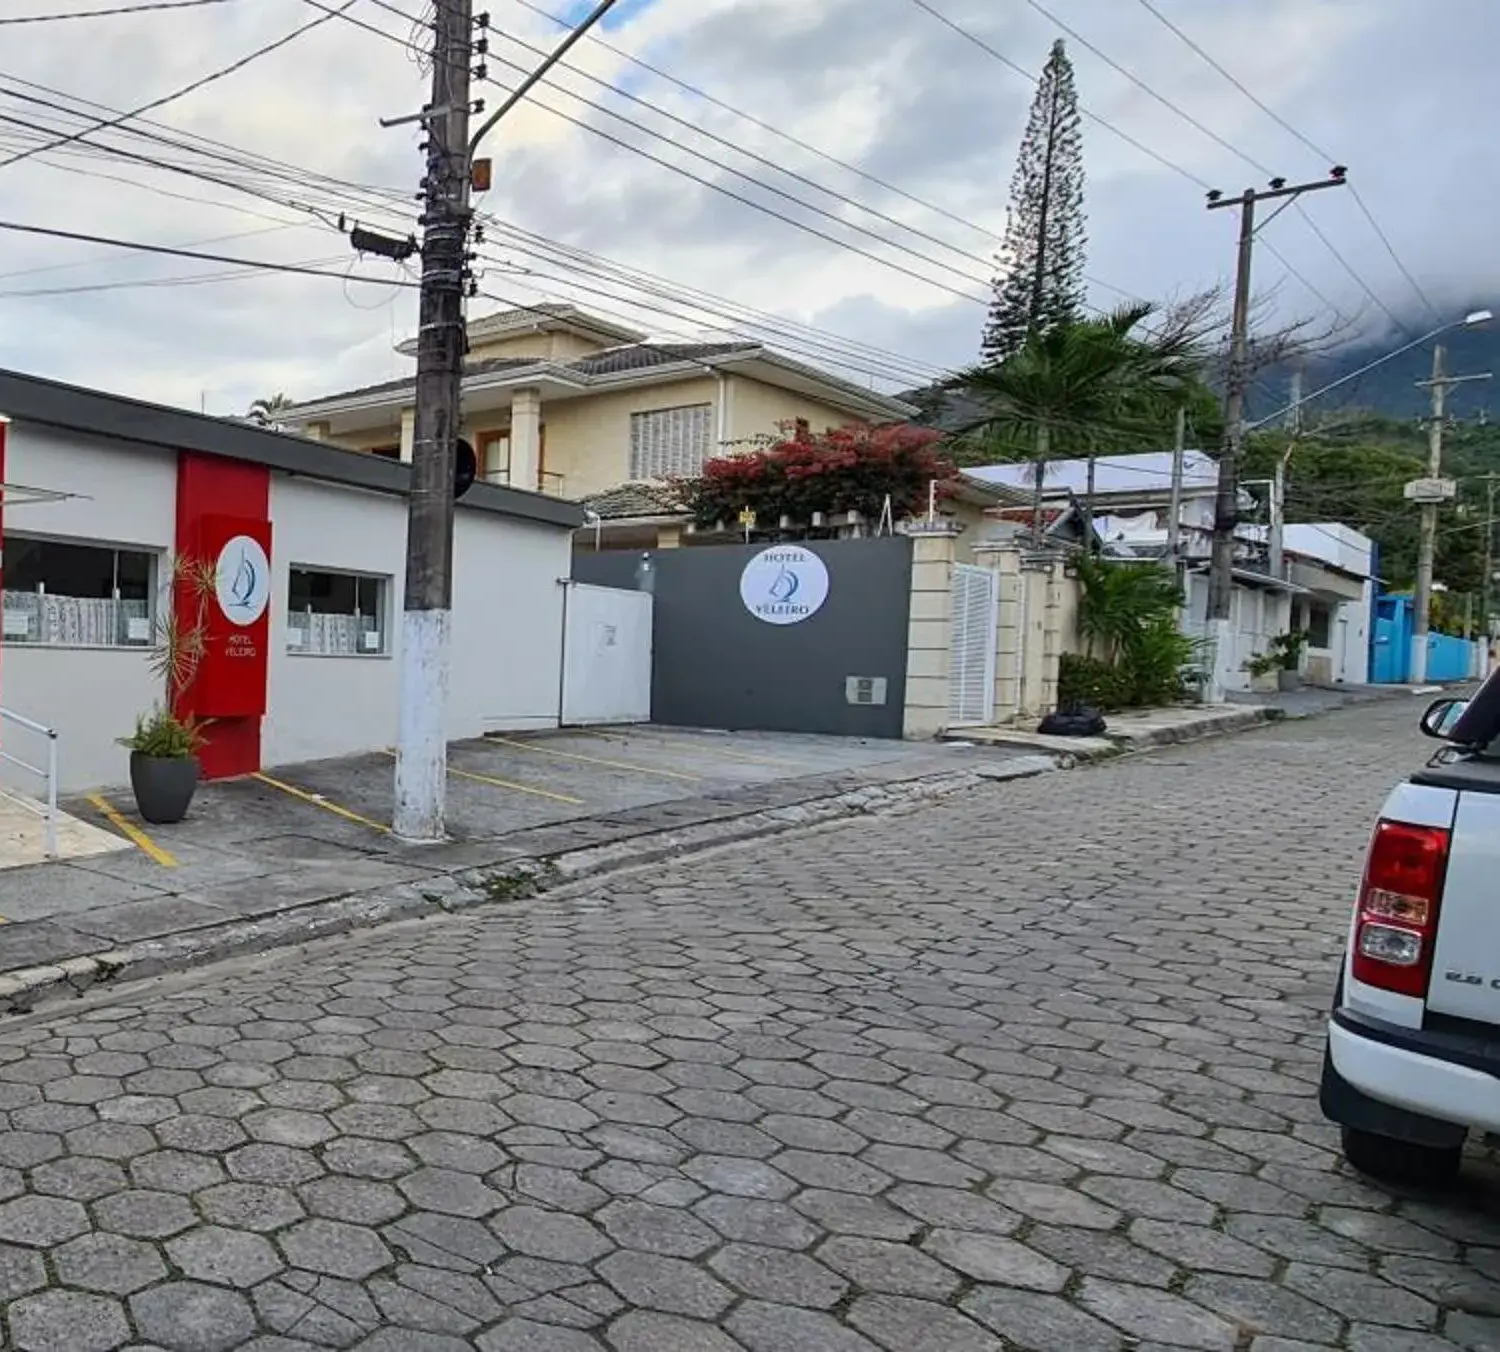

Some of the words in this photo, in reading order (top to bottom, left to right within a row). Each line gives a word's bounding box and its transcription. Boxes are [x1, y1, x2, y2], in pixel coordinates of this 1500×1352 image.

[764, 553, 805, 562] HOTEL
[756, 605, 809, 615] VELEIRO
[228, 634, 253, 645] HOTEL
